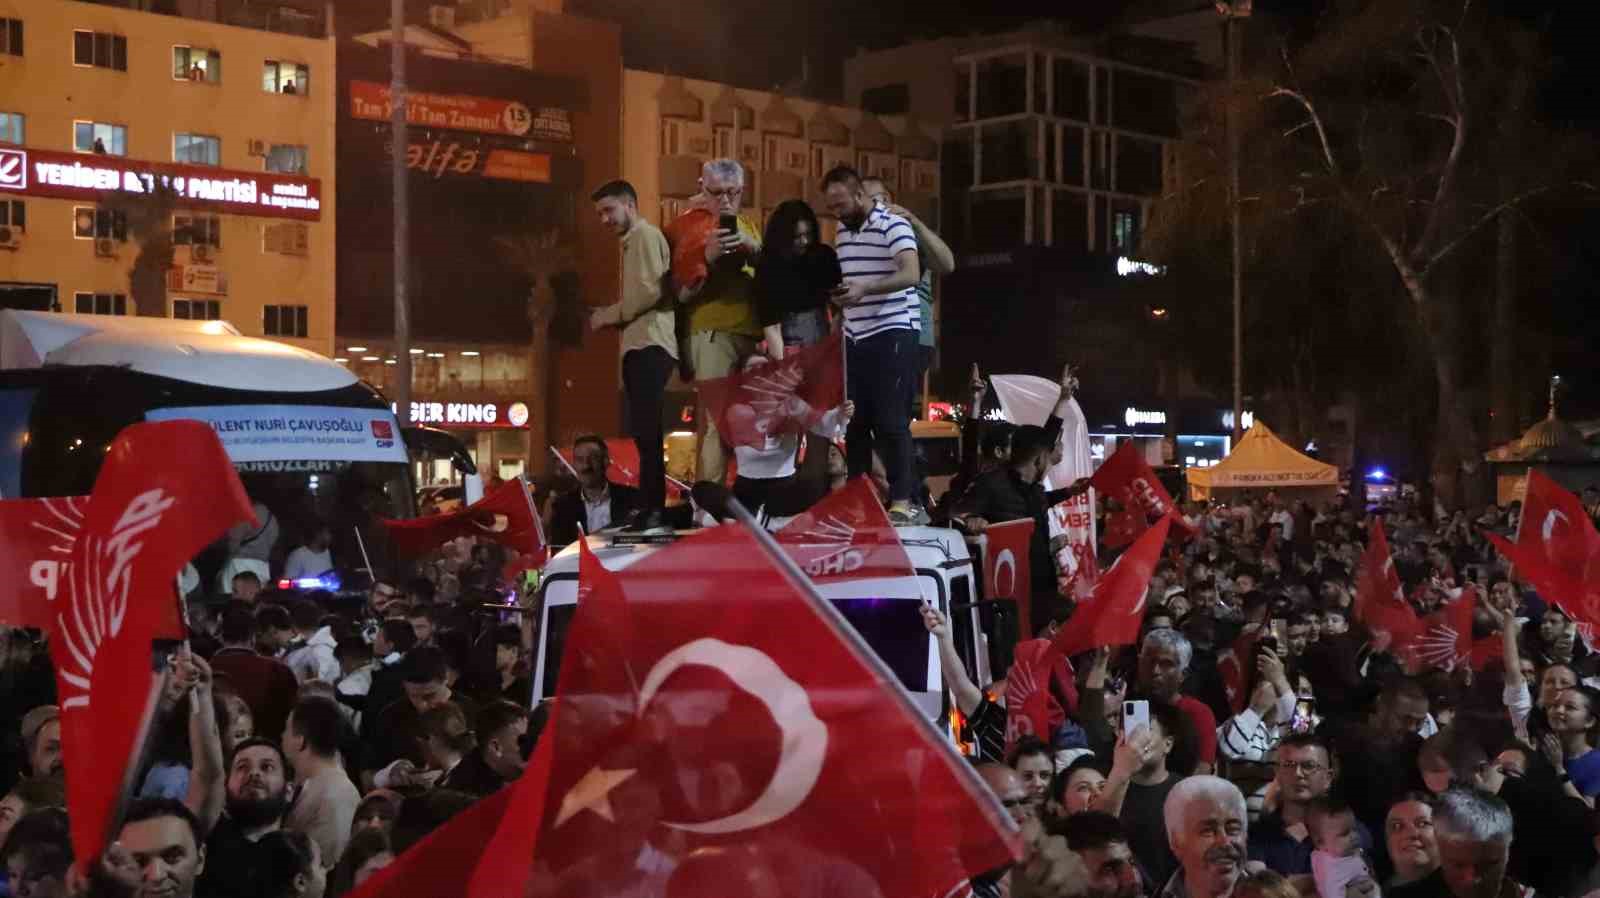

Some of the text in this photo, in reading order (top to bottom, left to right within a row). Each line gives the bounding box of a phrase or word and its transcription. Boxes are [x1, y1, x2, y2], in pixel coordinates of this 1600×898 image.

[353, 97, 383, 117] Tam
[419, 106, 447, 127] Tam
[35, 161, 120, 190] YENİDEN
[188, 177, 257, 204] PARTİSİ
[447, 403, 497, 423] KING
[208, 418, 363, 433] ÜLENT NURİ ÇAVUŞOĞLU
[376, 440, 393, 448] CHP
